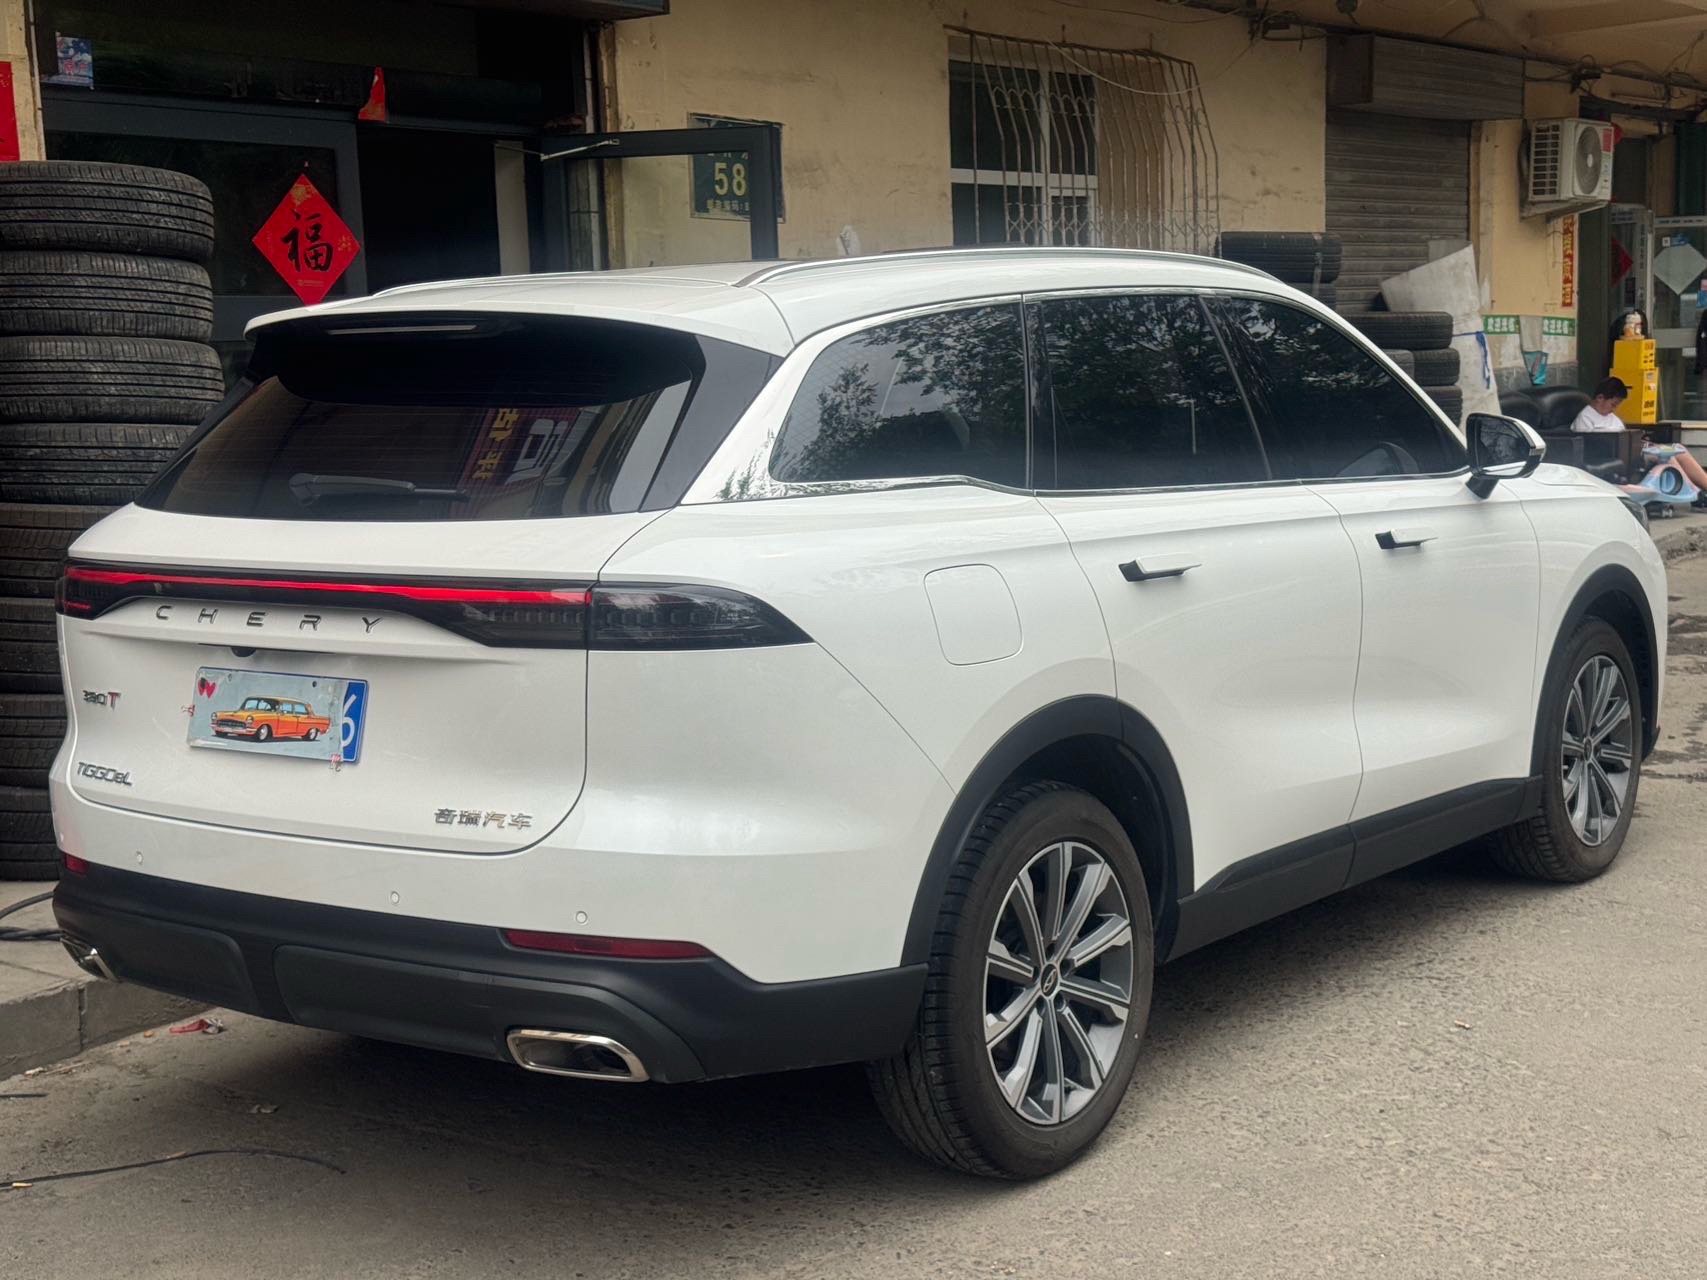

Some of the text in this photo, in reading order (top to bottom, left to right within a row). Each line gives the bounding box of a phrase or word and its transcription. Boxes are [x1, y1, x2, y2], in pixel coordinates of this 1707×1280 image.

[713, 162, 746, 197] 58
[282, 208, 334, 273] 福
[155, 604, 383, 634] CHERY
[434, 808, 533, 830] 奇瑞汽车
